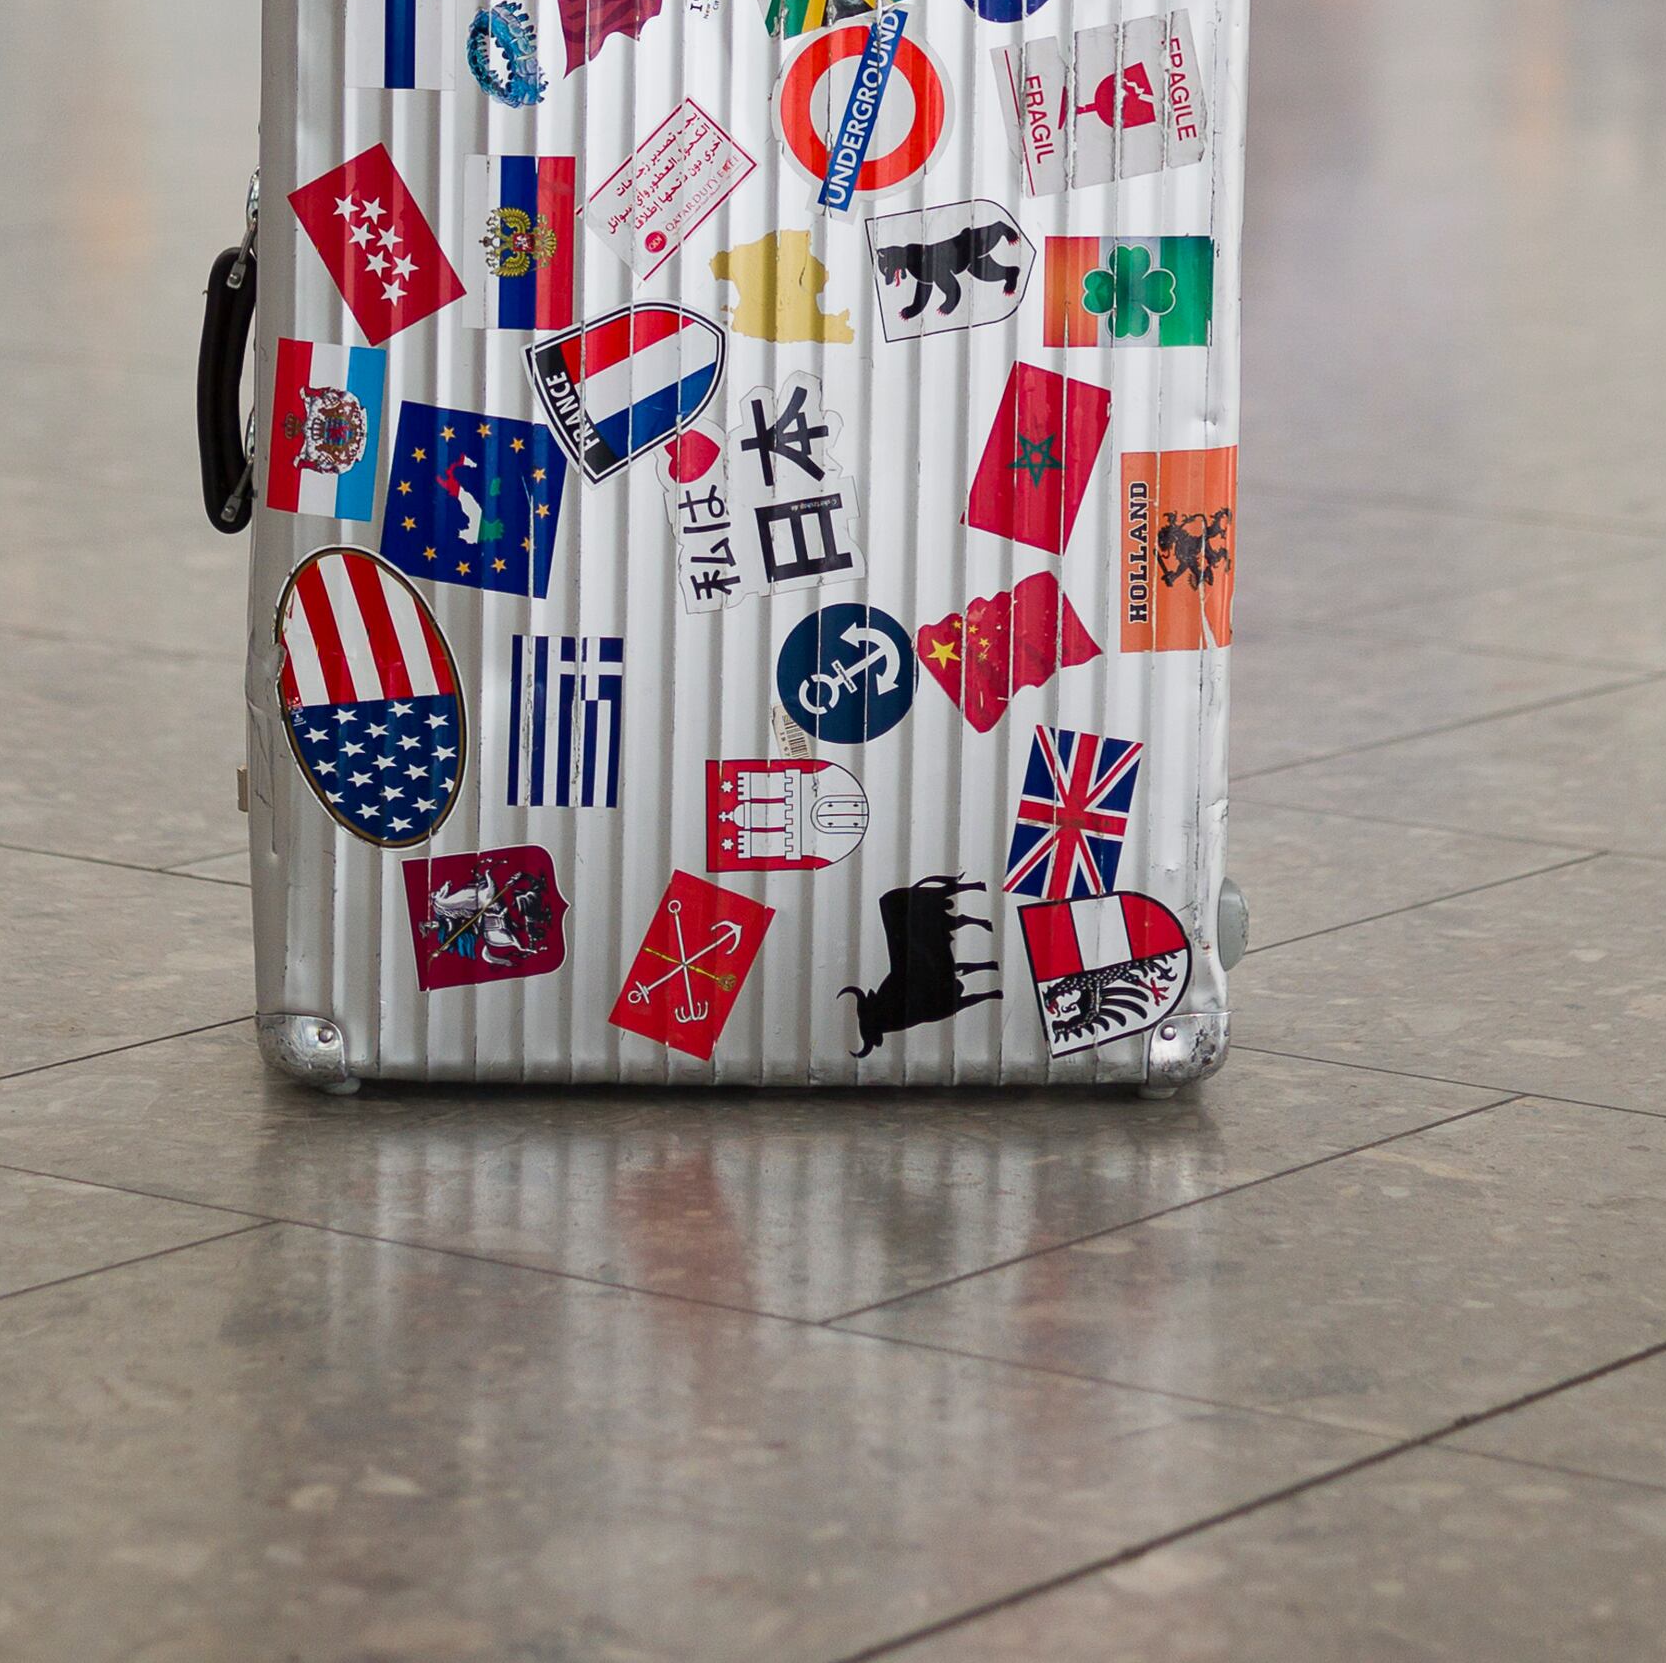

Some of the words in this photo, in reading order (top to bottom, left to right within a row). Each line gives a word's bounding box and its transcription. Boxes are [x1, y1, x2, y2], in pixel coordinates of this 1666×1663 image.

[690, 3, 703, 12] I
[827, 10, 899, 204] UNDERGROUND
[1025, 75, 1054, 164] FRAGIL
[545, 371, 600, 451] FRANCE
[678, 484, 741, 600] 私は
[741, 386, 853, 583] 日本
[1129, 481, 1149, 624] HOLLAND
